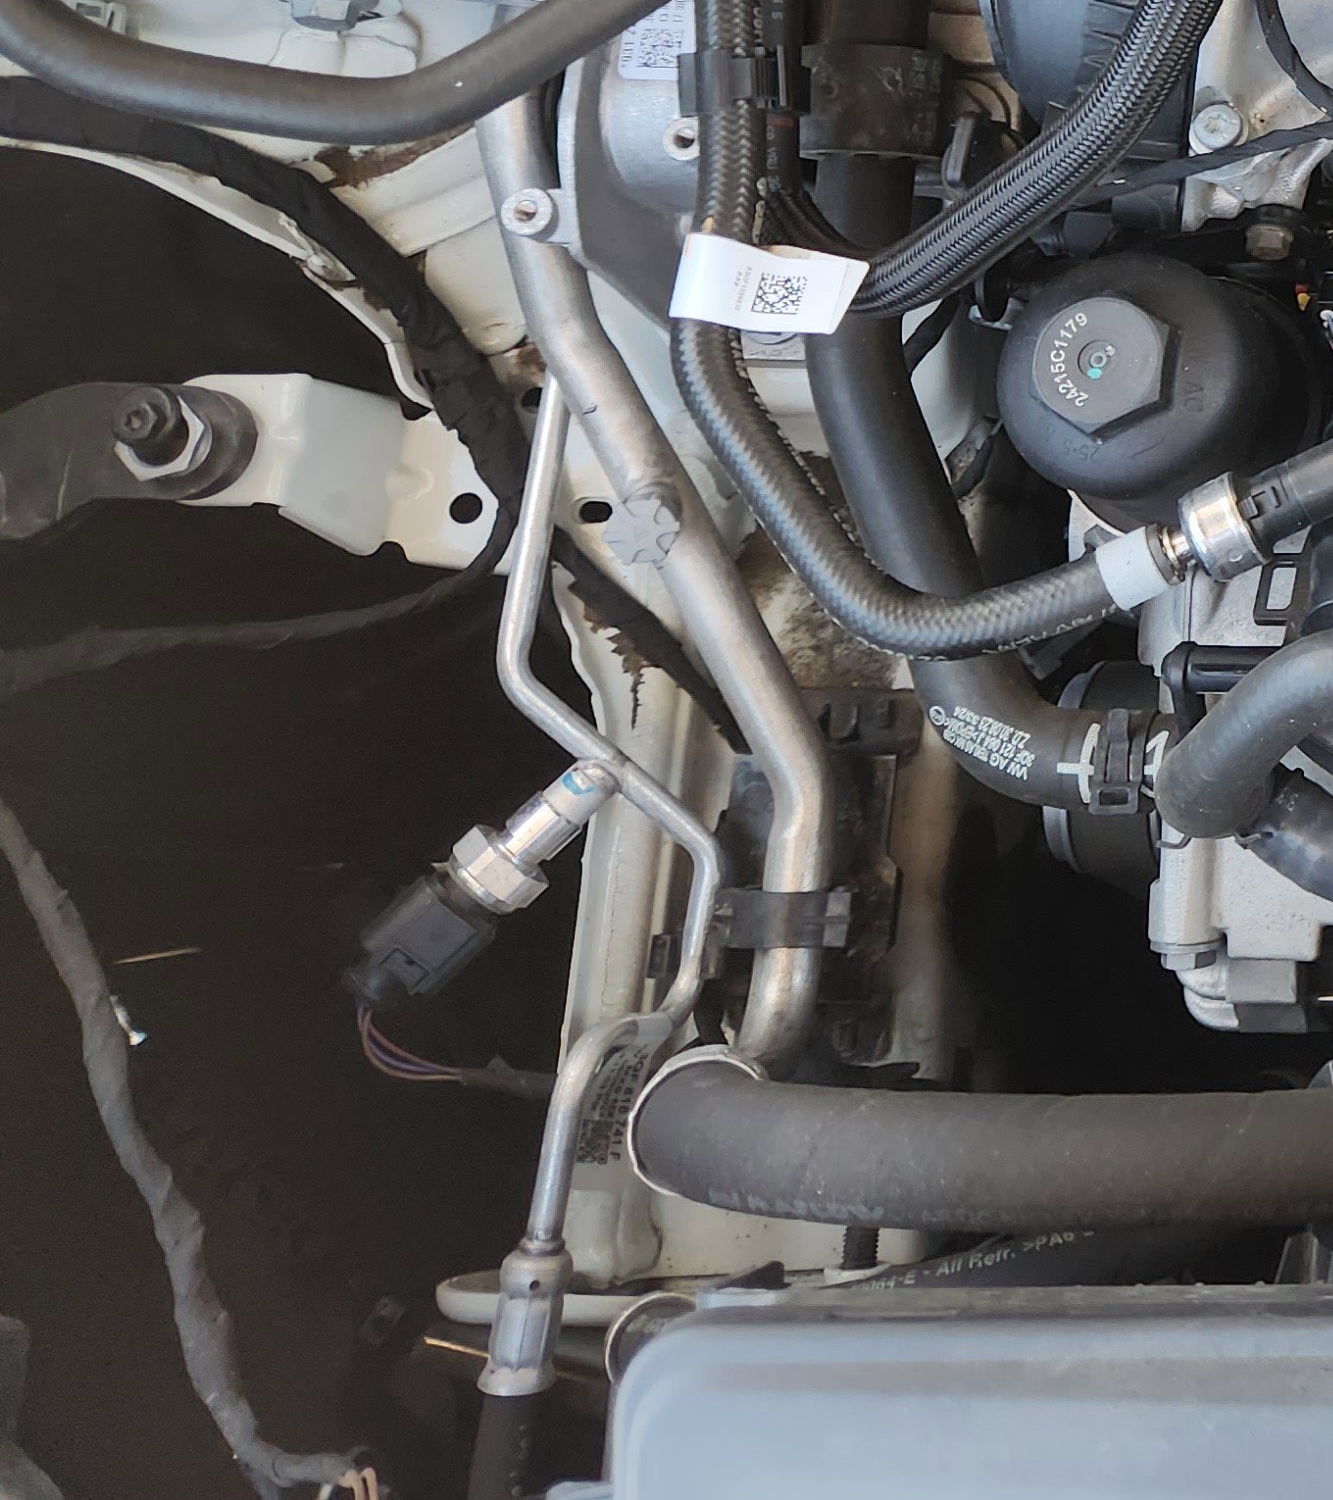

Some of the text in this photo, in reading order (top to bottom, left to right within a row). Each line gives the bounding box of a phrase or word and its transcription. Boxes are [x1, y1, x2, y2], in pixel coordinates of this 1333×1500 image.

[1050, 312, 1088, 406] 24215C1179
[986, 751, 1009, 771] AG
[1005, 760, 1030, 781] VW
